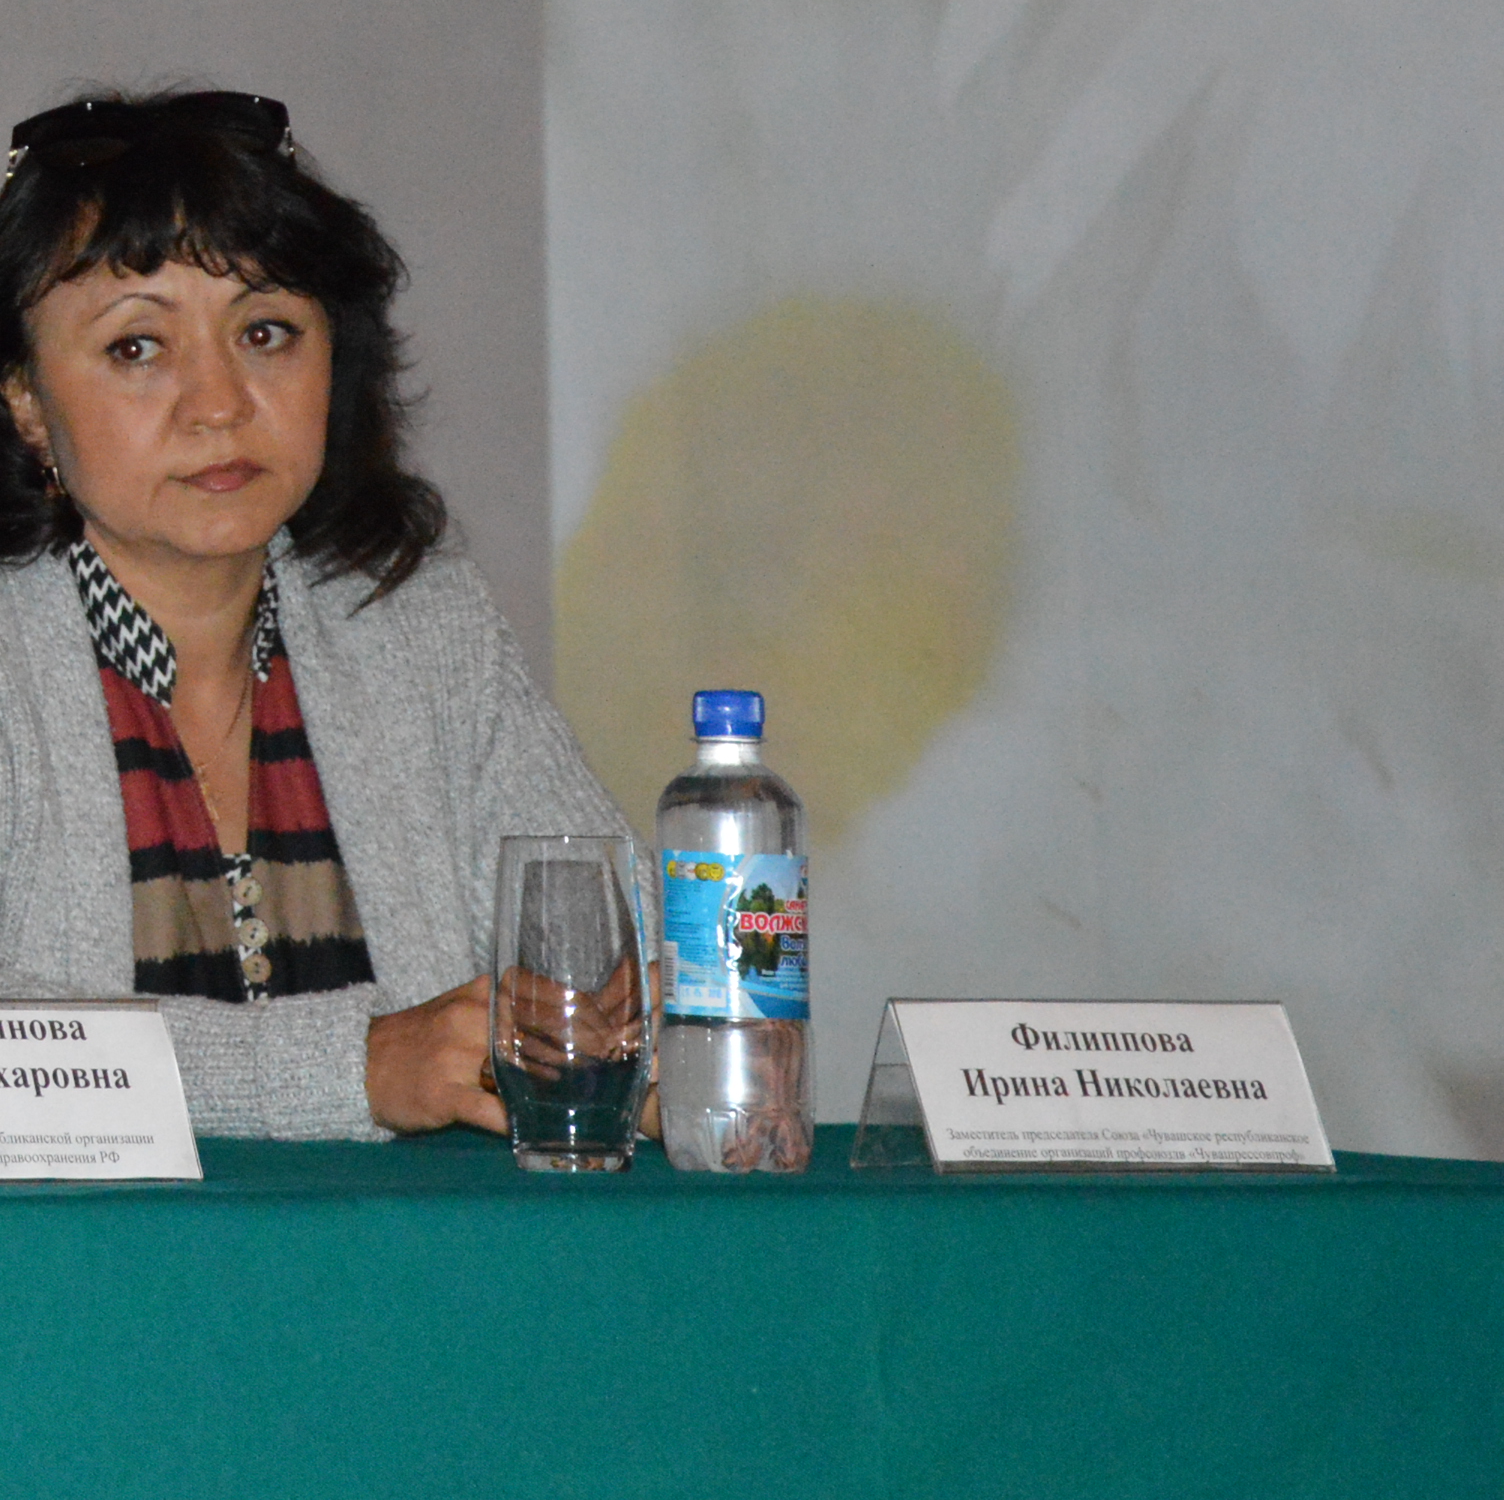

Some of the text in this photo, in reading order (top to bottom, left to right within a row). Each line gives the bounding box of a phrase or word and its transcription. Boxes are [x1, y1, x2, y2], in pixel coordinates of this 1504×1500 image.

[1010, 1022, 1195, 1053] Филиппова
[960, 1068, 1268, 1105] Ирина Николаевна
[74, 1134, 155, 1148] организации
[945, 1128, 1020, 1141] Заместитель
[1021, 1130, 1101, 1144] председателя
[1100, 1127, 1141, 1142] Союза
[1213, 1129, 1310, 1146] республиканское
[99, 1150, 121, 1164] РФ
[962, 1145, 1038, 1161] объединение
[1038, 1146, 1114, 1162] организаций
